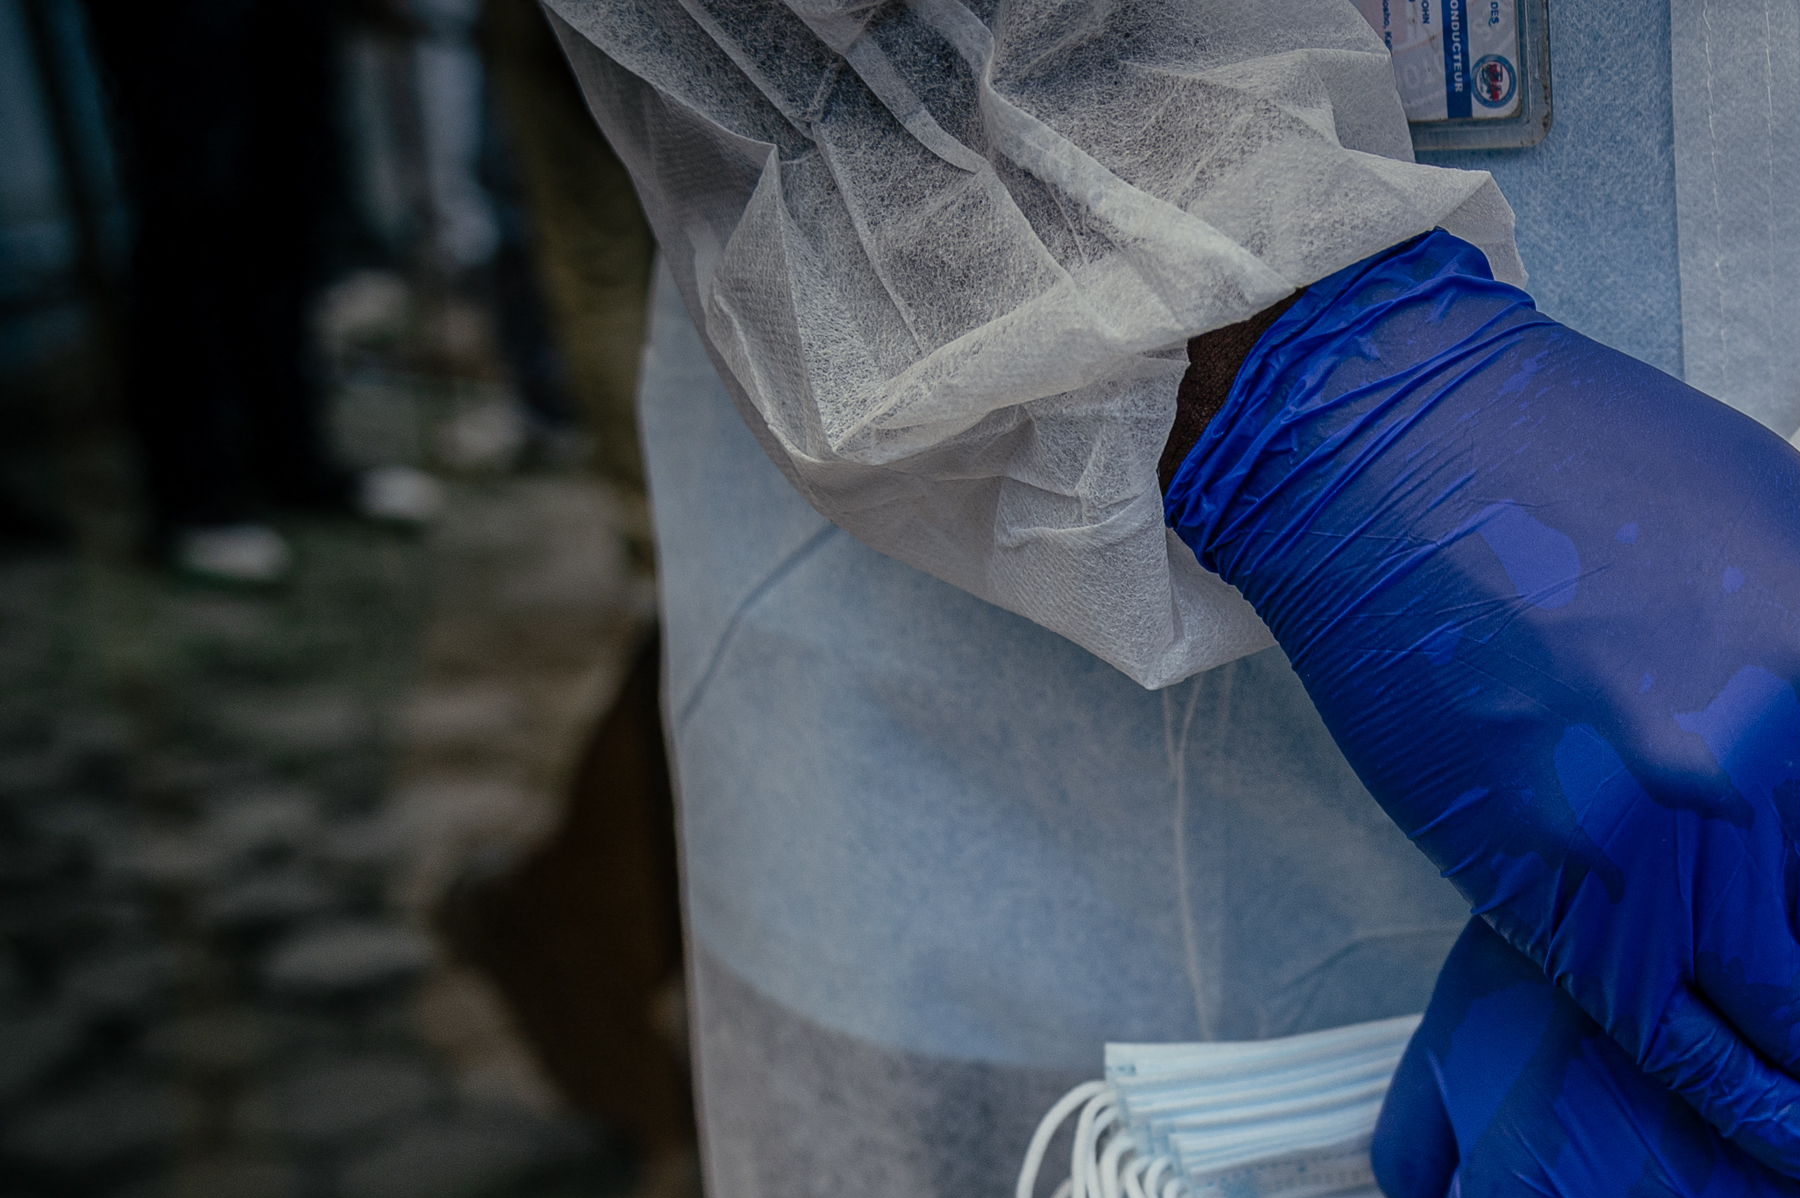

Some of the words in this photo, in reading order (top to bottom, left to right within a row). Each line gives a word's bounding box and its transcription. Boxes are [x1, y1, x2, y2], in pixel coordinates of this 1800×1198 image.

[1421, 0, 1430, 25] OHN
[1490, 1, 1500, 24] DES
[1449, 0, 1464, 93] ONDUCTEUR
